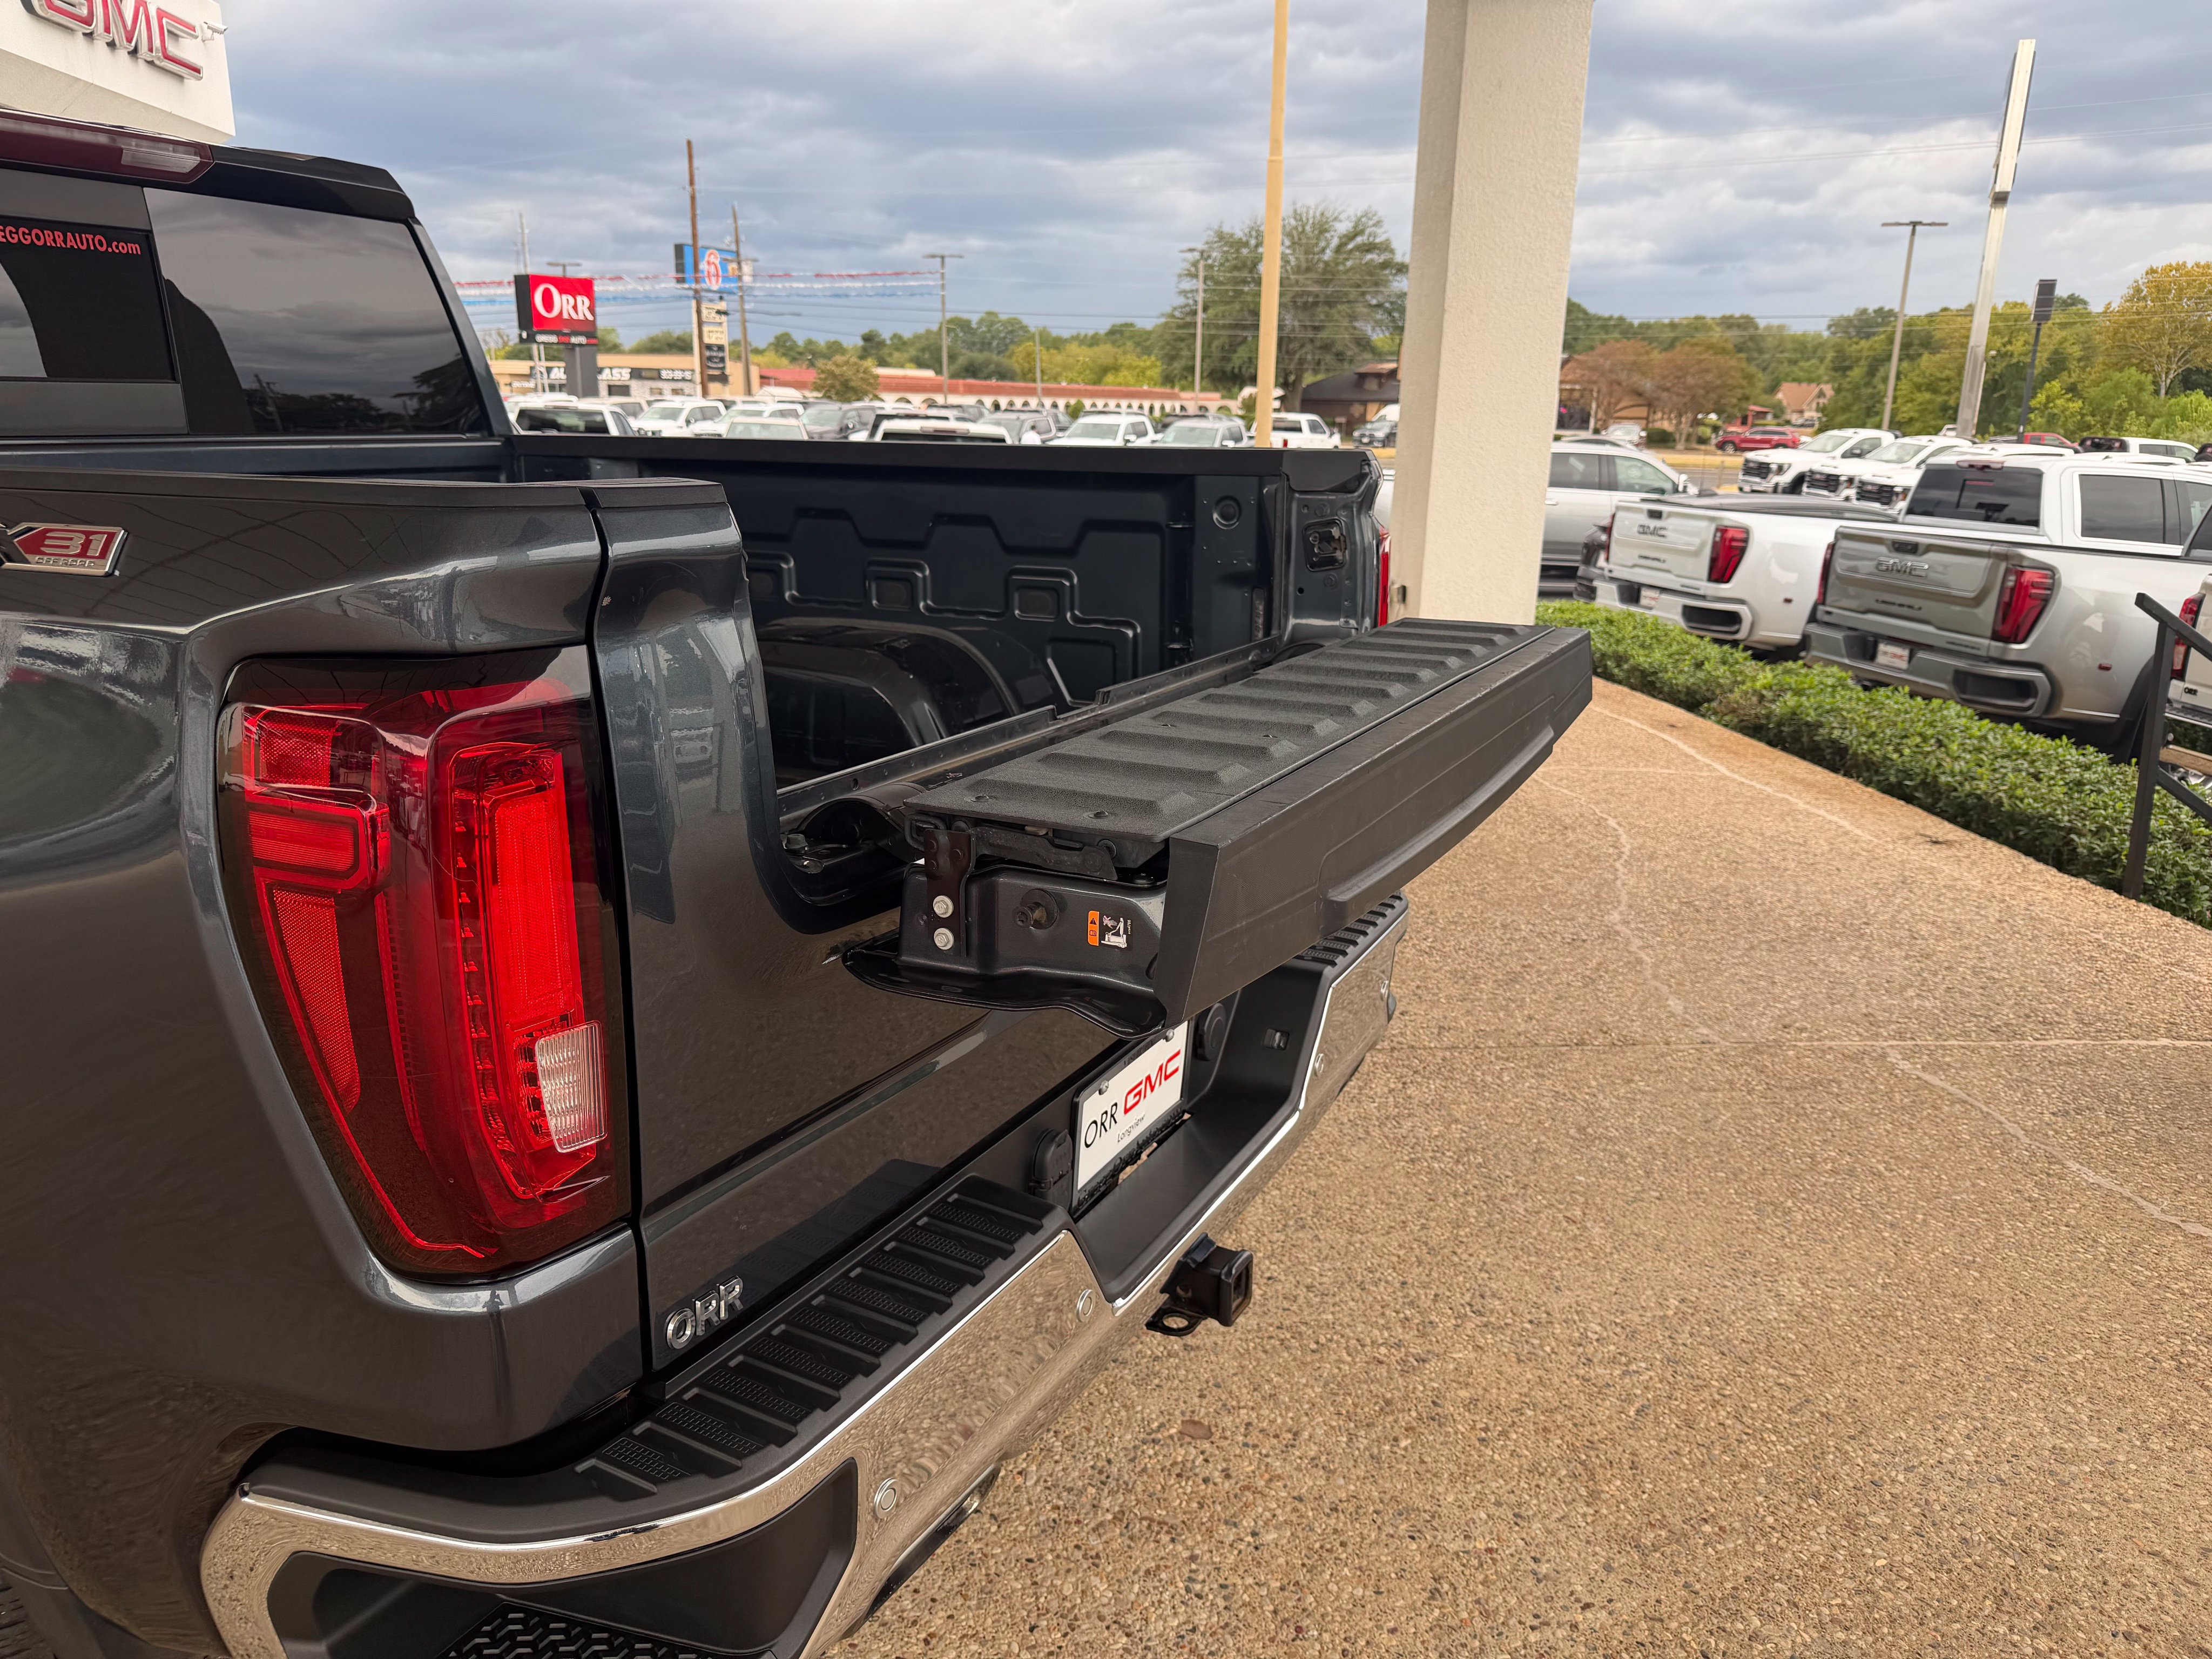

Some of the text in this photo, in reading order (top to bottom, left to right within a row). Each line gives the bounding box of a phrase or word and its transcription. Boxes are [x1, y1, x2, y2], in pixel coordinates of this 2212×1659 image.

[1637, 524, 1668, 538] GMC
[1876, 556, 1929, 578] GMC
[1084, 1102, 1118, 1149] ORR
[1124, 1049, 1181, 1115] GMC
[1117, 1115, 1146, 1143] Longview
[666, 1275, 744, 1349] ORR
